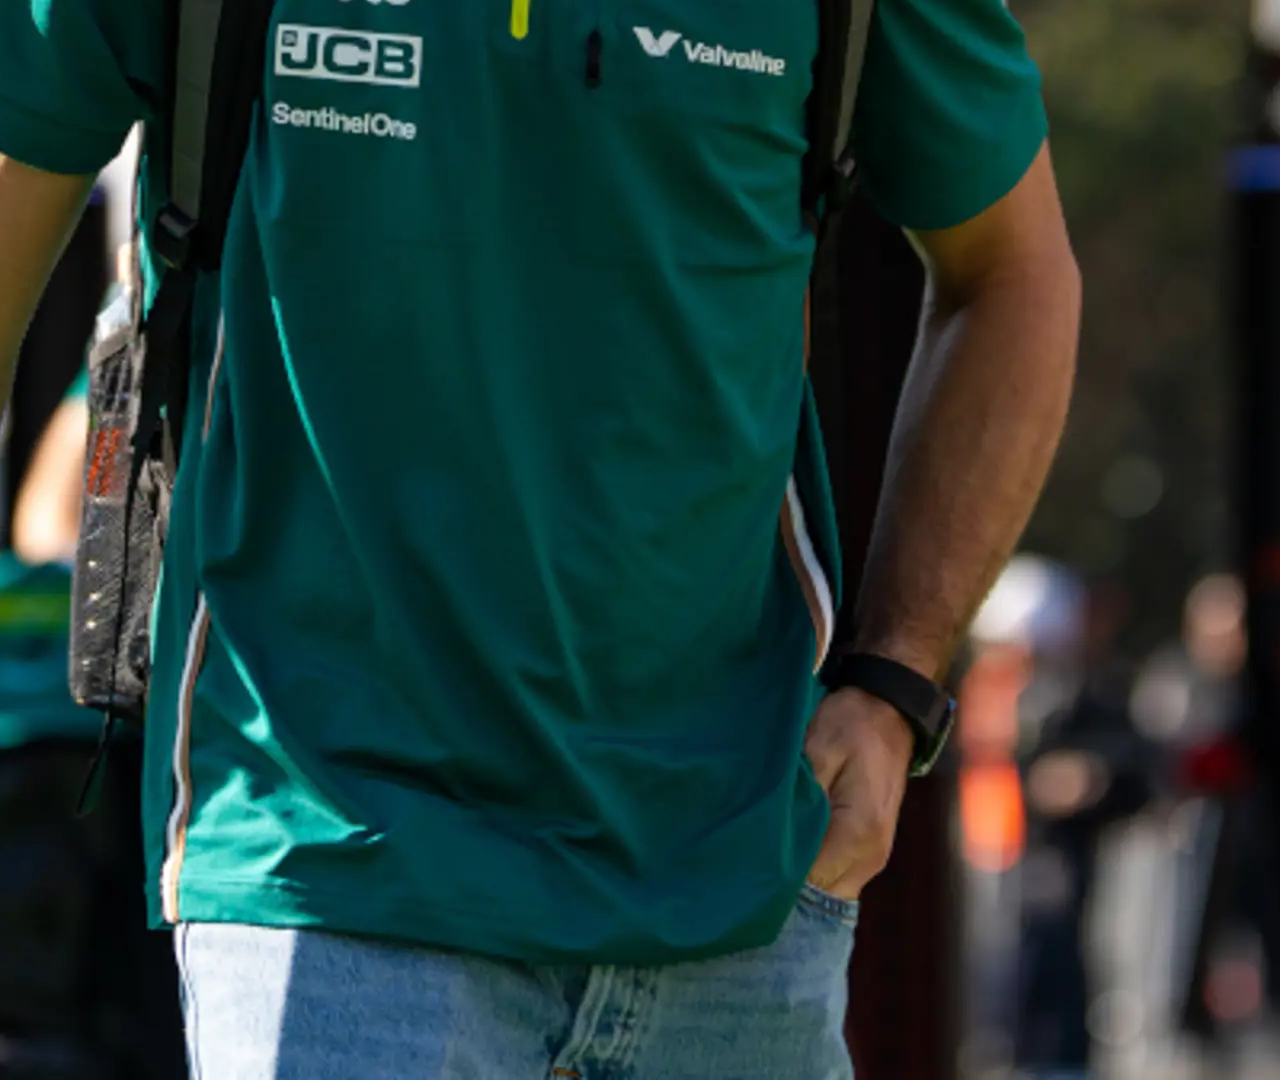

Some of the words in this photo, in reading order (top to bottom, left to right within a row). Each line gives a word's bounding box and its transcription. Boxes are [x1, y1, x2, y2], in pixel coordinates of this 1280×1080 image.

[280, 30, 418, 80] JCB
[681, 39, 785, 76] Valvoline
[272, 102, 417, 140] SentinelOne
